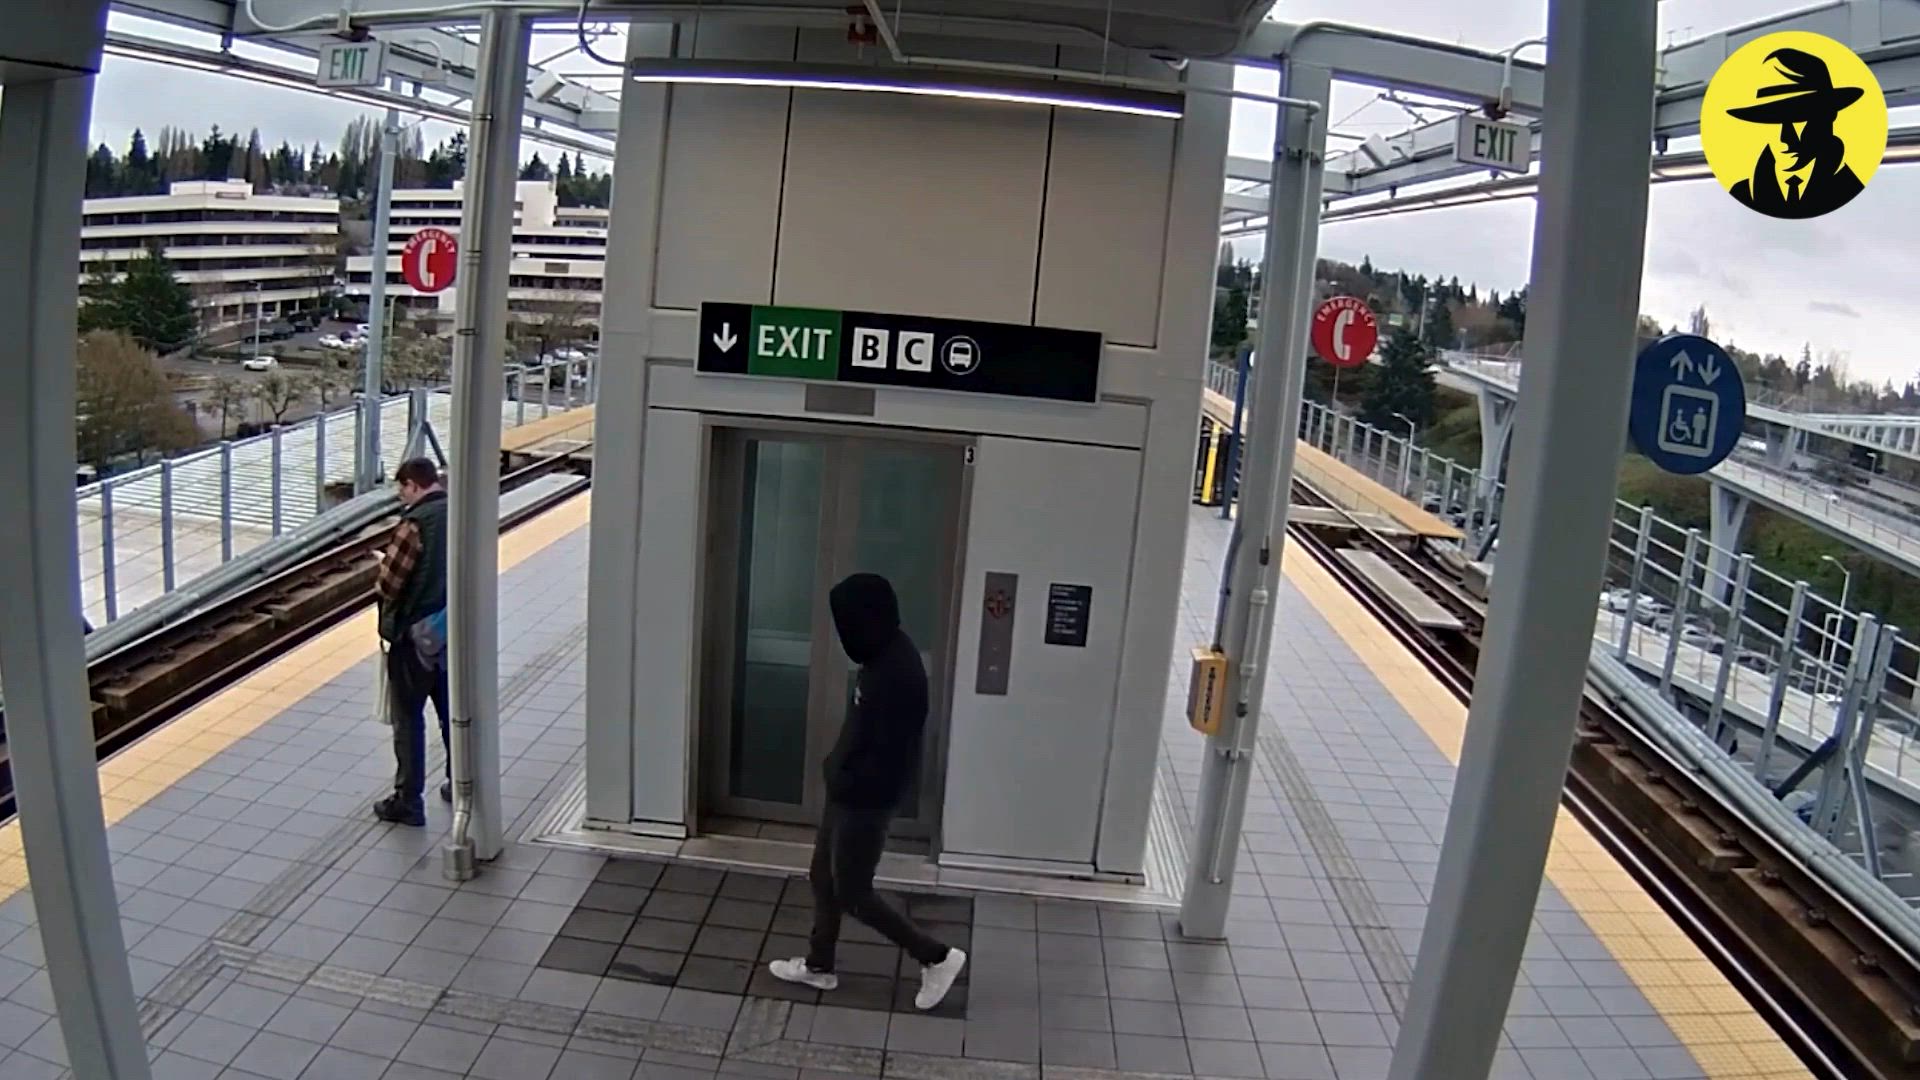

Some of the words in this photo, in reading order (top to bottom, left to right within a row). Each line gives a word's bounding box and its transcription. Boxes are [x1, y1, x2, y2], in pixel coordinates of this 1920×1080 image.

[329, 48, 369, 80] EXIT
[1474, 124, 1518, 163] EXIT
[1316, 300, 1376, 327] EMERGENCY
[757, 325, 833, 360] EXIT
[861, 334, 880, 361] B
[904, 338, 925, 365] C
[967, 447, 974, 464] 3
